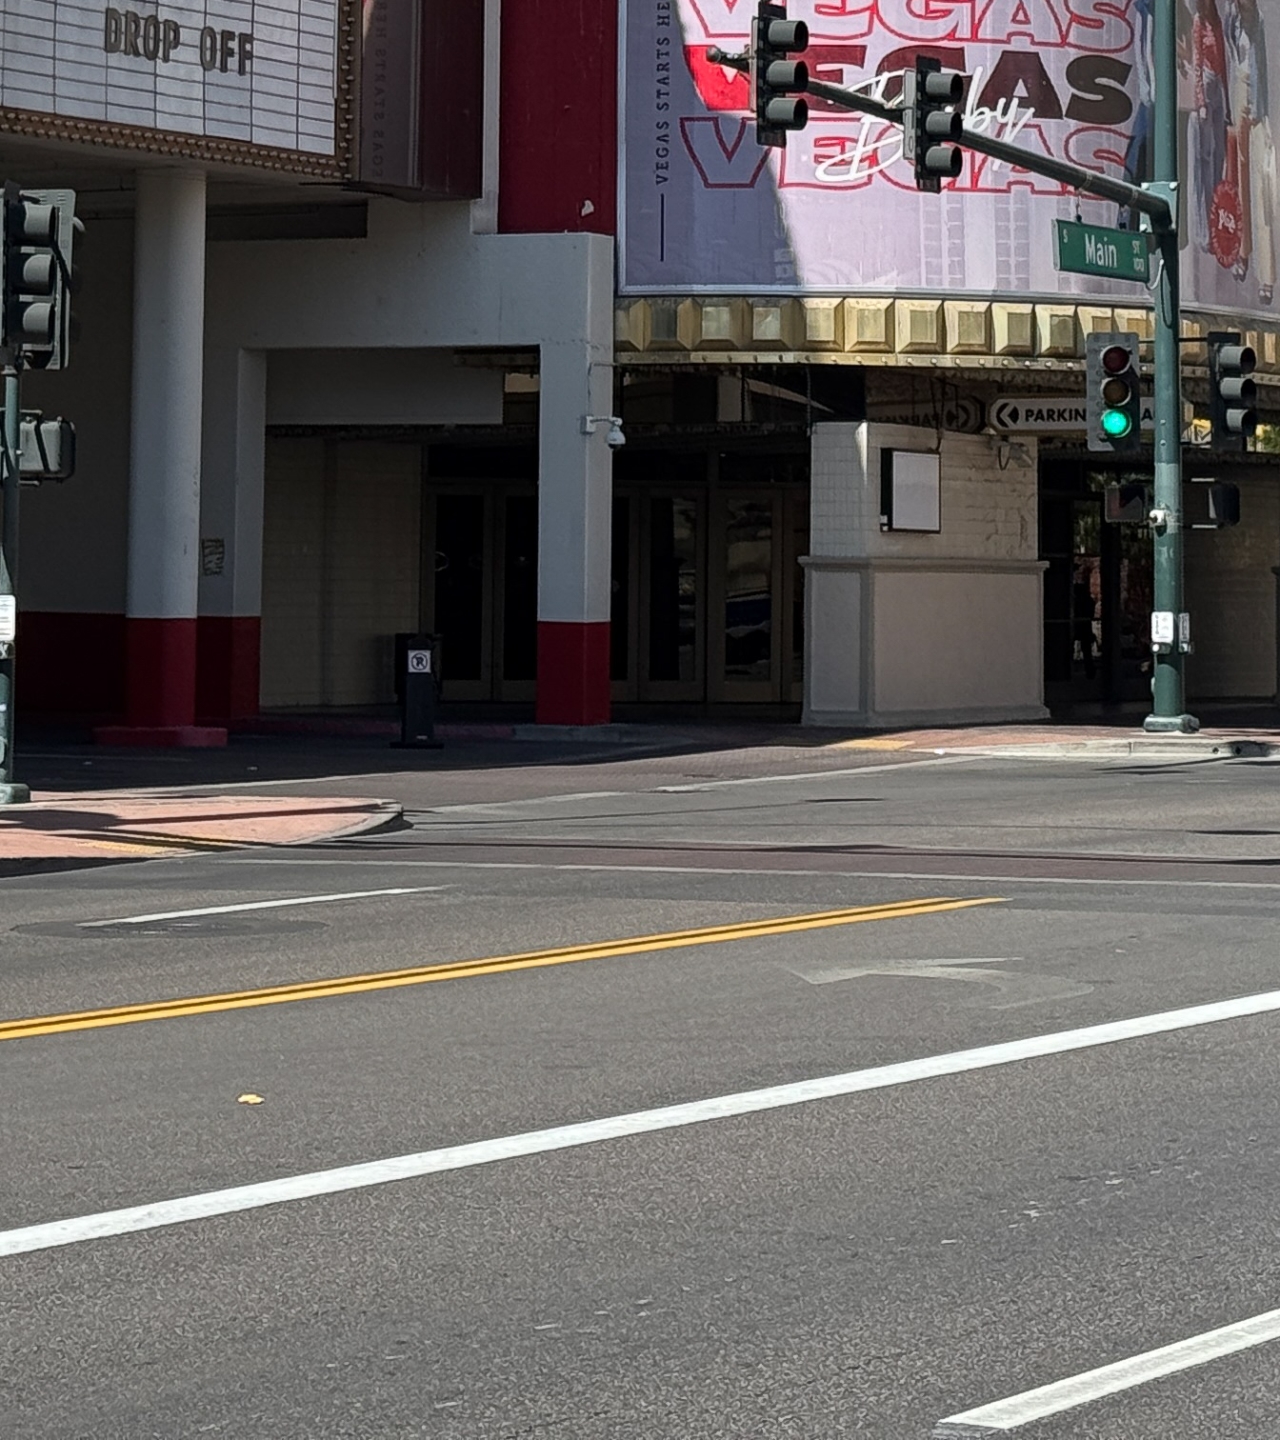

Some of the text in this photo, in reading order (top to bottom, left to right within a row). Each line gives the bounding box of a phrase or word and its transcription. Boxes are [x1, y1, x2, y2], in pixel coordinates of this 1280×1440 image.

[104, 7, 253, 76] DROP OFF
[656, 37, 670, 112] STARTS
[656, 121, 670, 185] VEGAS
[1063, 229, 1068, 243] S
[1085, 233, 1117, 268] Main
[1025, 407, 1087, 422] PARKIN
